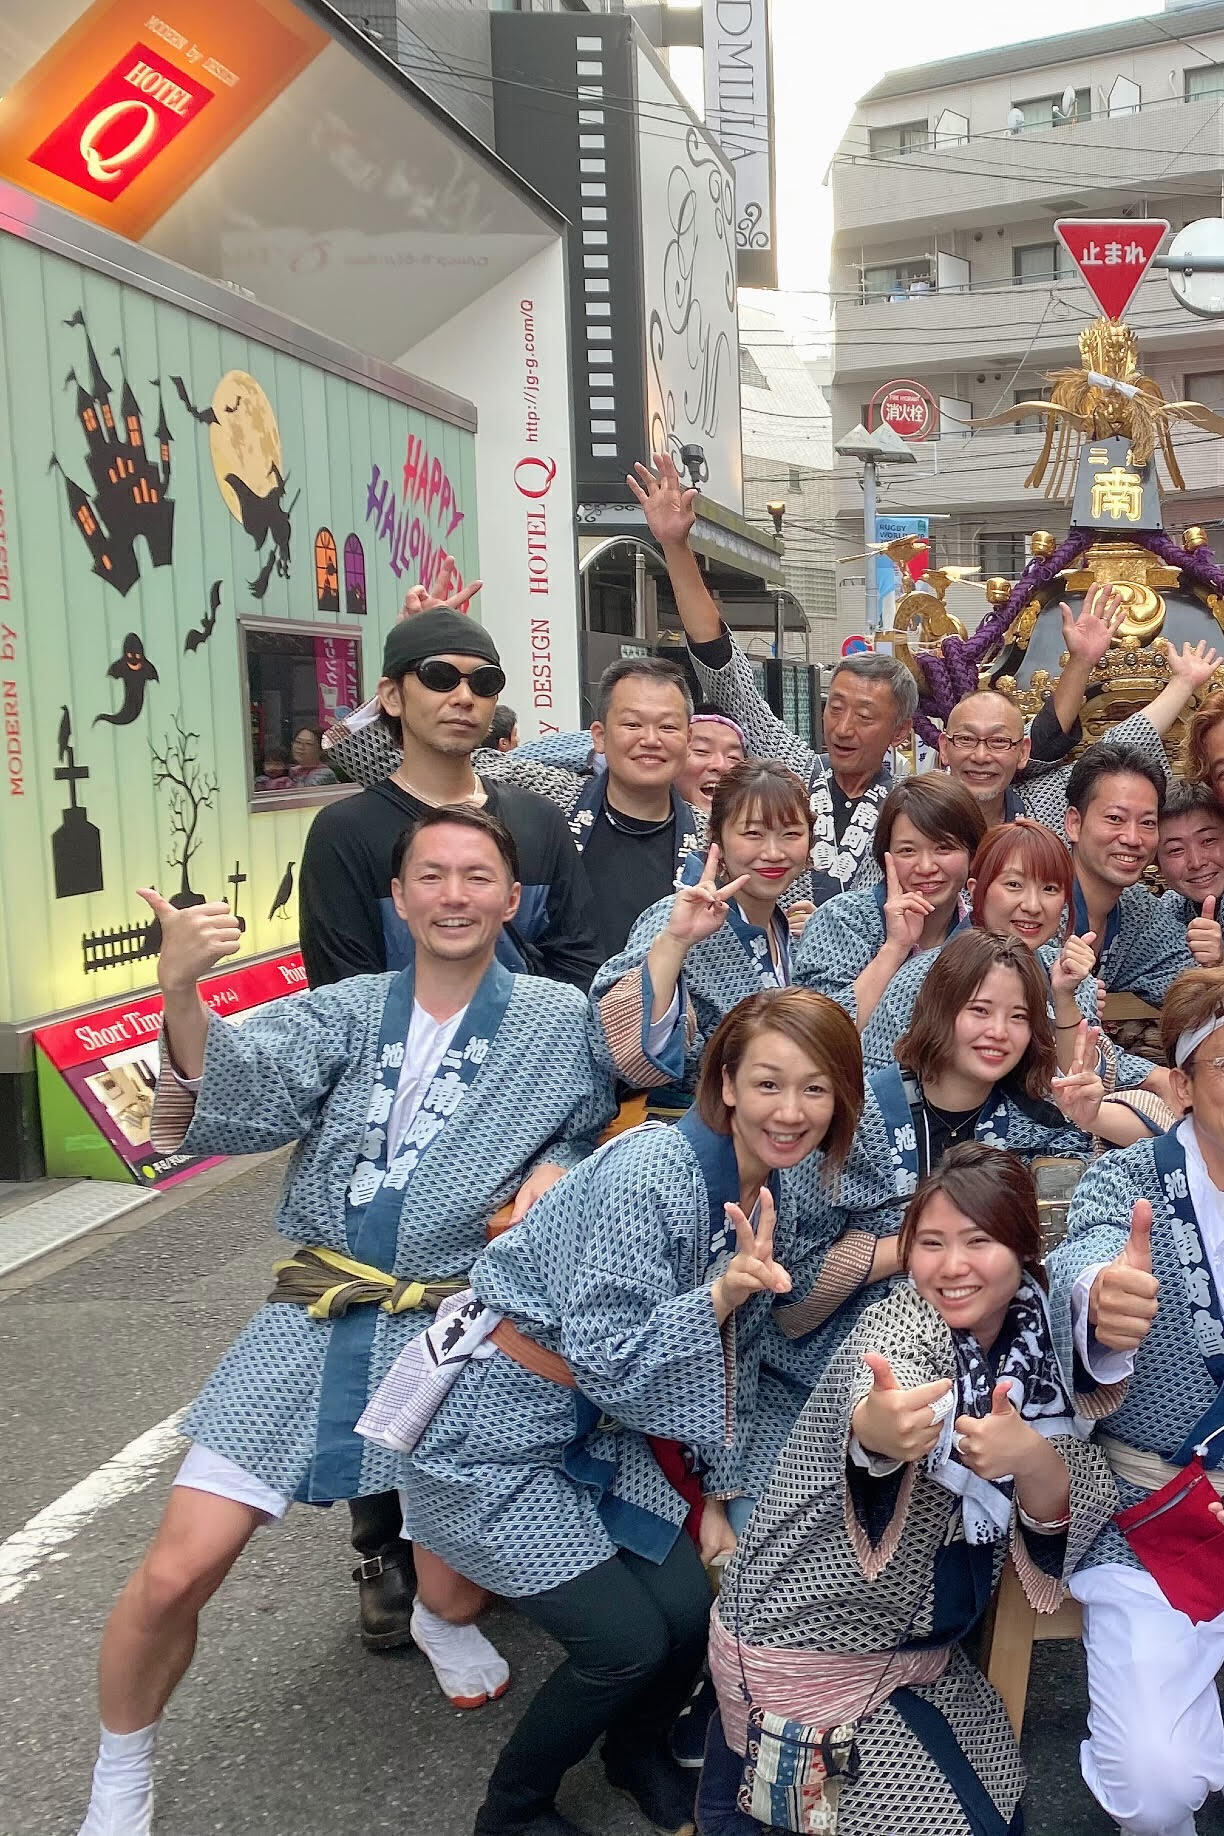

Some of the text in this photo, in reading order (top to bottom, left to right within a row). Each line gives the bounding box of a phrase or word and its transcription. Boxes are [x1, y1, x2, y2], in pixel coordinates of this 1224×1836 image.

[123, 60, 195, 117] HOTEL
[79, 99, 158, 182] Q
[1080, 241, 1147, 265] 止まれ
[886, 403, 924, 422] 消火栓
[403, 434, 465, 538] HAPPY
[513, 456, 557, 499] Q
[1090, 466, 1144, 522] 南
[365, 464, 471, 614] HALLOW
[526, 504, 550, 595] HOTEL
[530, 618, 553, 709] DESIGN
[2, 680, 25, 797] MODERN
[277, 962, 308, 985] Poin
[75, 1008, 164, 1052] Short Tim
